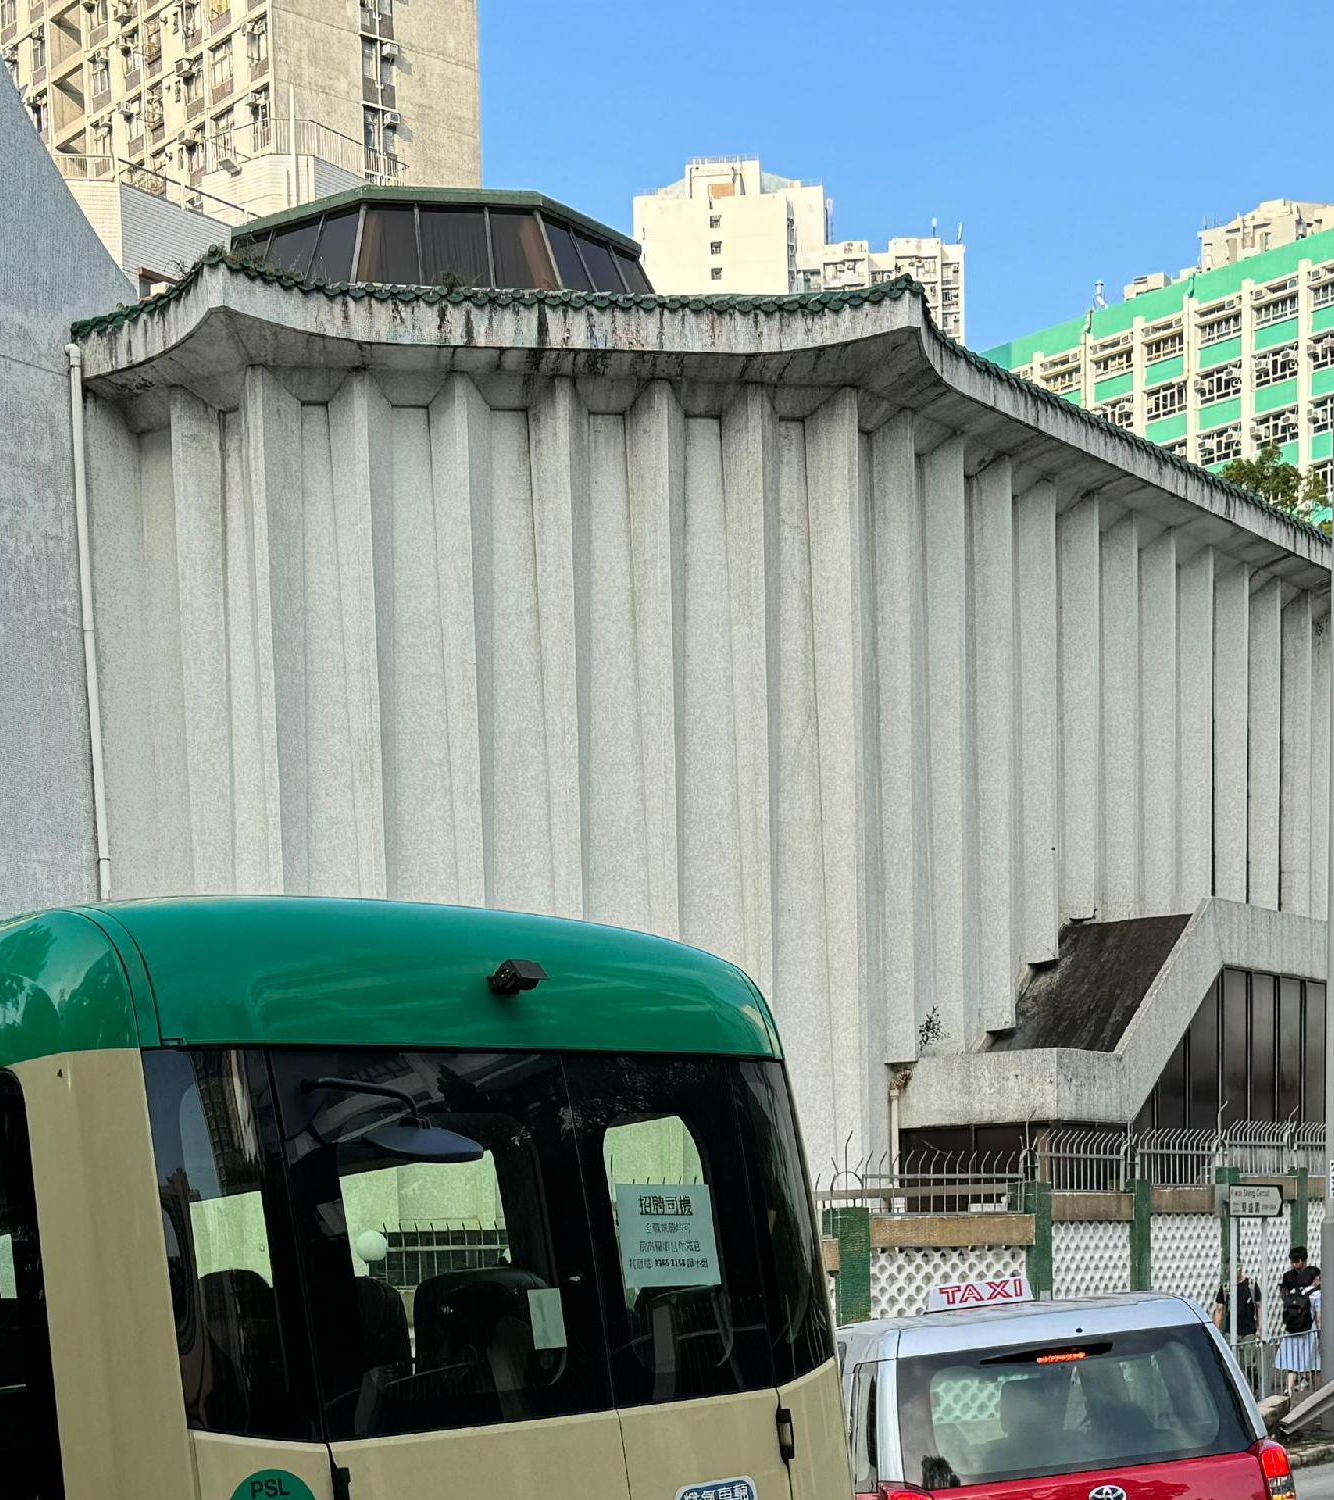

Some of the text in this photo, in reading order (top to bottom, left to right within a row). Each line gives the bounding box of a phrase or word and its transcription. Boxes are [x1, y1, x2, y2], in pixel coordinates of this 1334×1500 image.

[638, 1194, 692, 1214] 招聘司機
[938, 1279, 1023, 1305] TAXI
[250, 1477, 291, 1499] PSL
